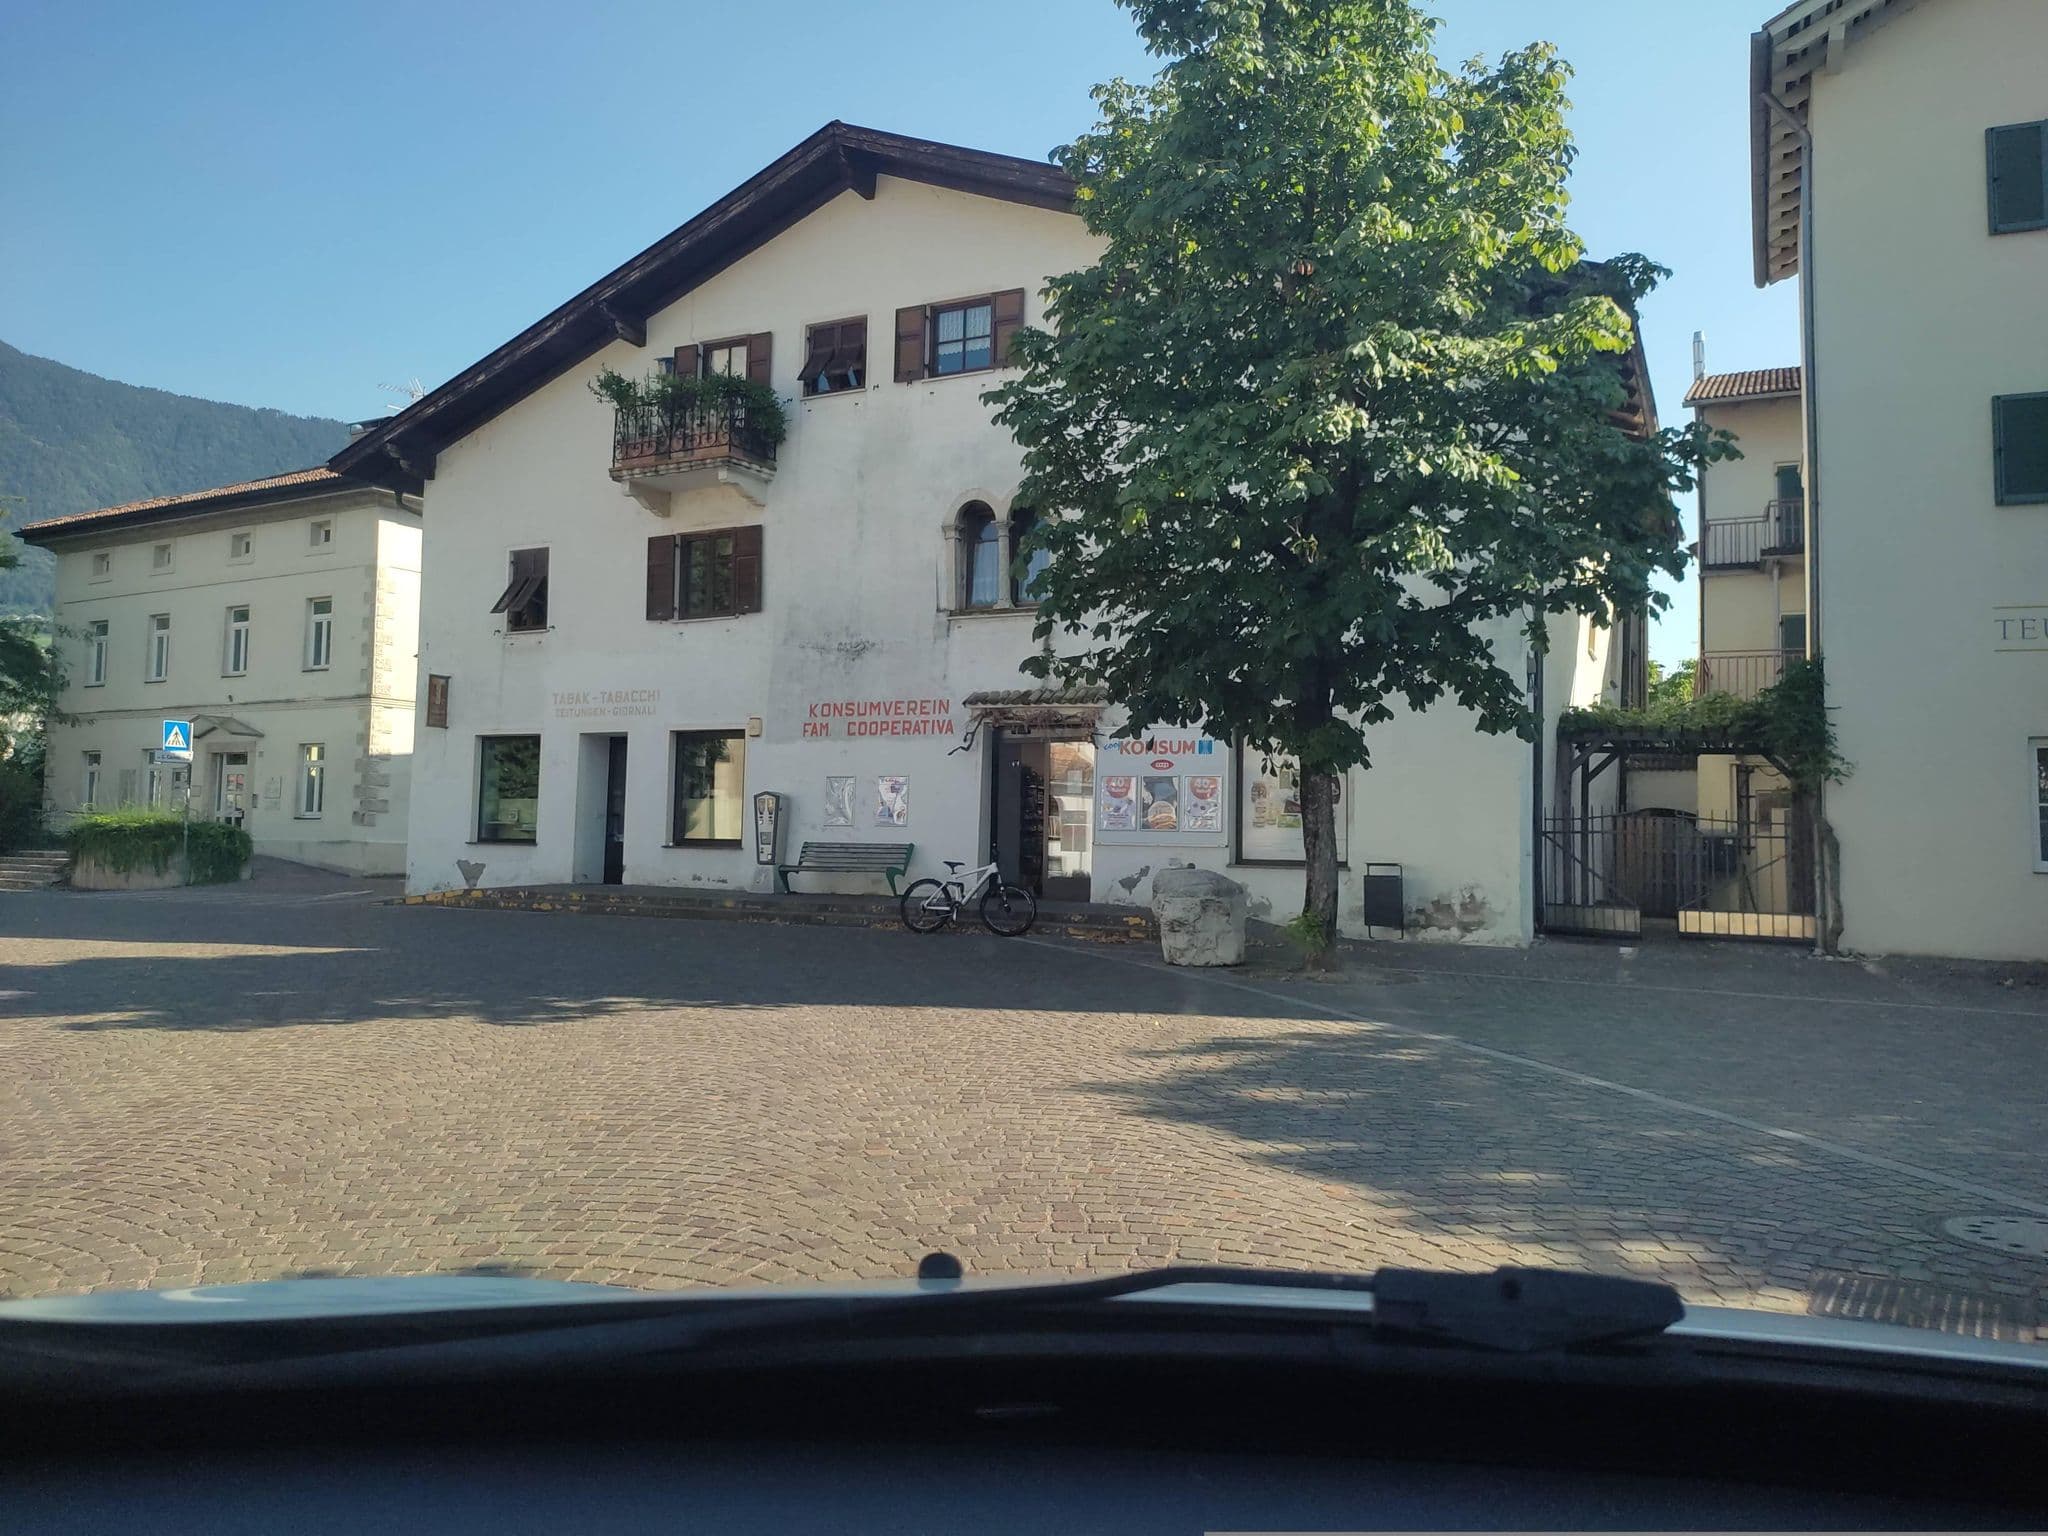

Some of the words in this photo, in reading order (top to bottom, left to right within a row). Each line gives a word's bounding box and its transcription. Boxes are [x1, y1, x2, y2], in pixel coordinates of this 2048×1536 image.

[1993, 617, 2048, 640] TE
[809, 699, 950, 718] KONSUMVEREIN
[802, 722, 831, 737] FAM.
[842, 719, 954, 737] COOPERATIVA
[1120, 739, 1196, 755] KONSUM
